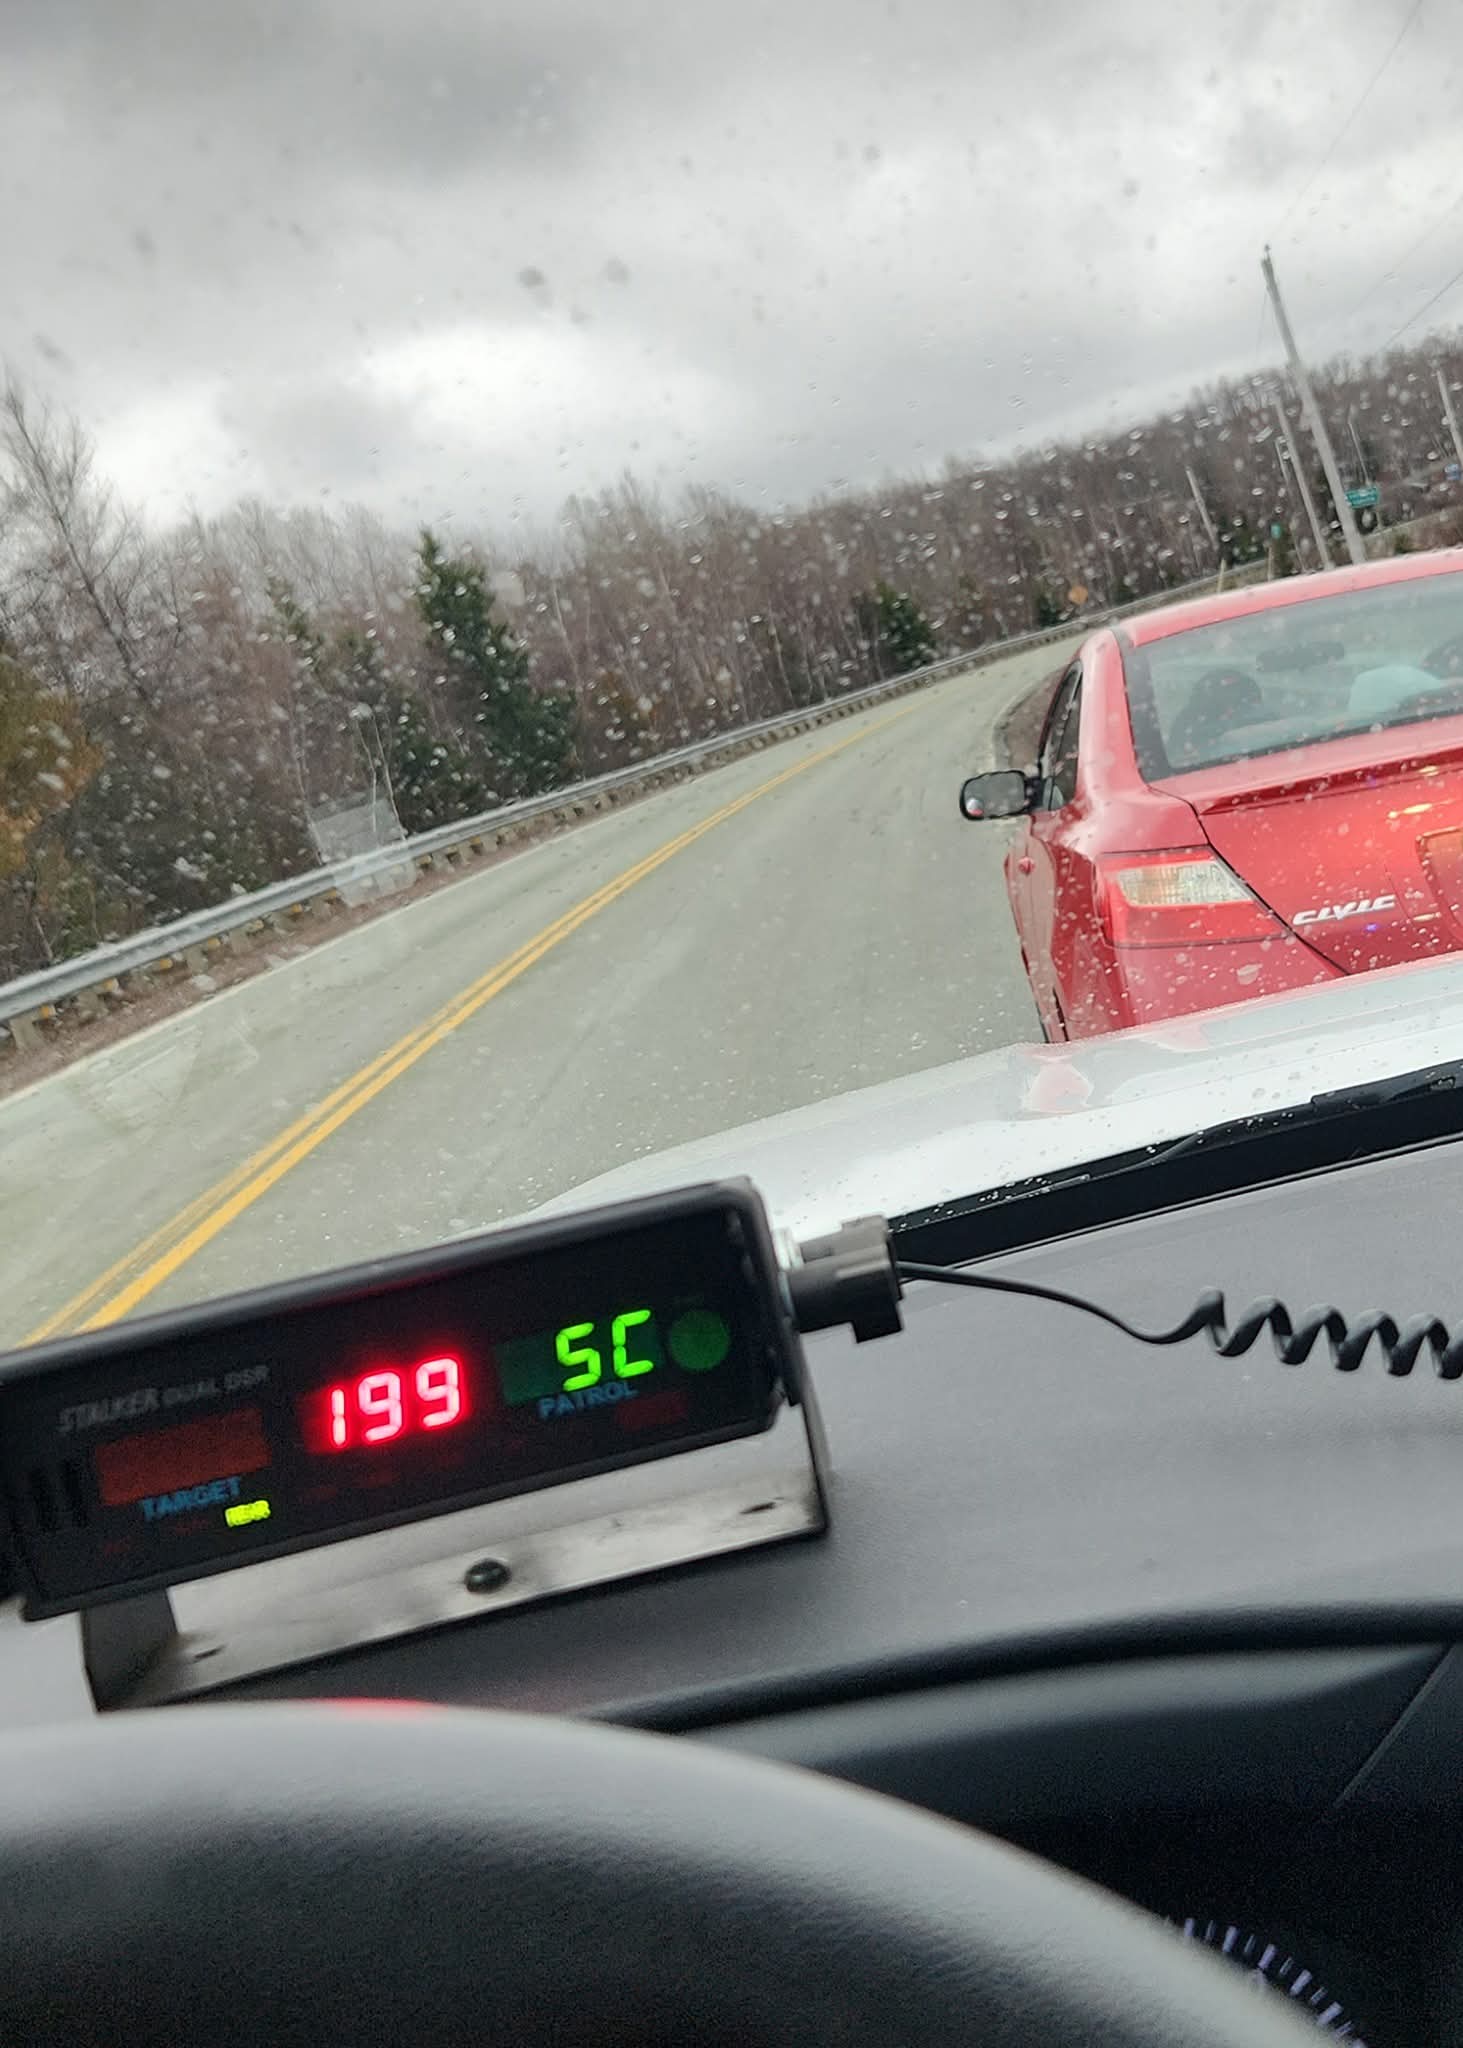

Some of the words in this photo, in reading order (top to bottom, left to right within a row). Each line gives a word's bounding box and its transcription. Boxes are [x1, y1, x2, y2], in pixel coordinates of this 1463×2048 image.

[1292, 894, 1396, 926] CIVIC
[329, 1356, 462, 1447] 199
[537, 1381, 639, 1419] PATROL
[138, 1475, 242, 1521] TARGET
